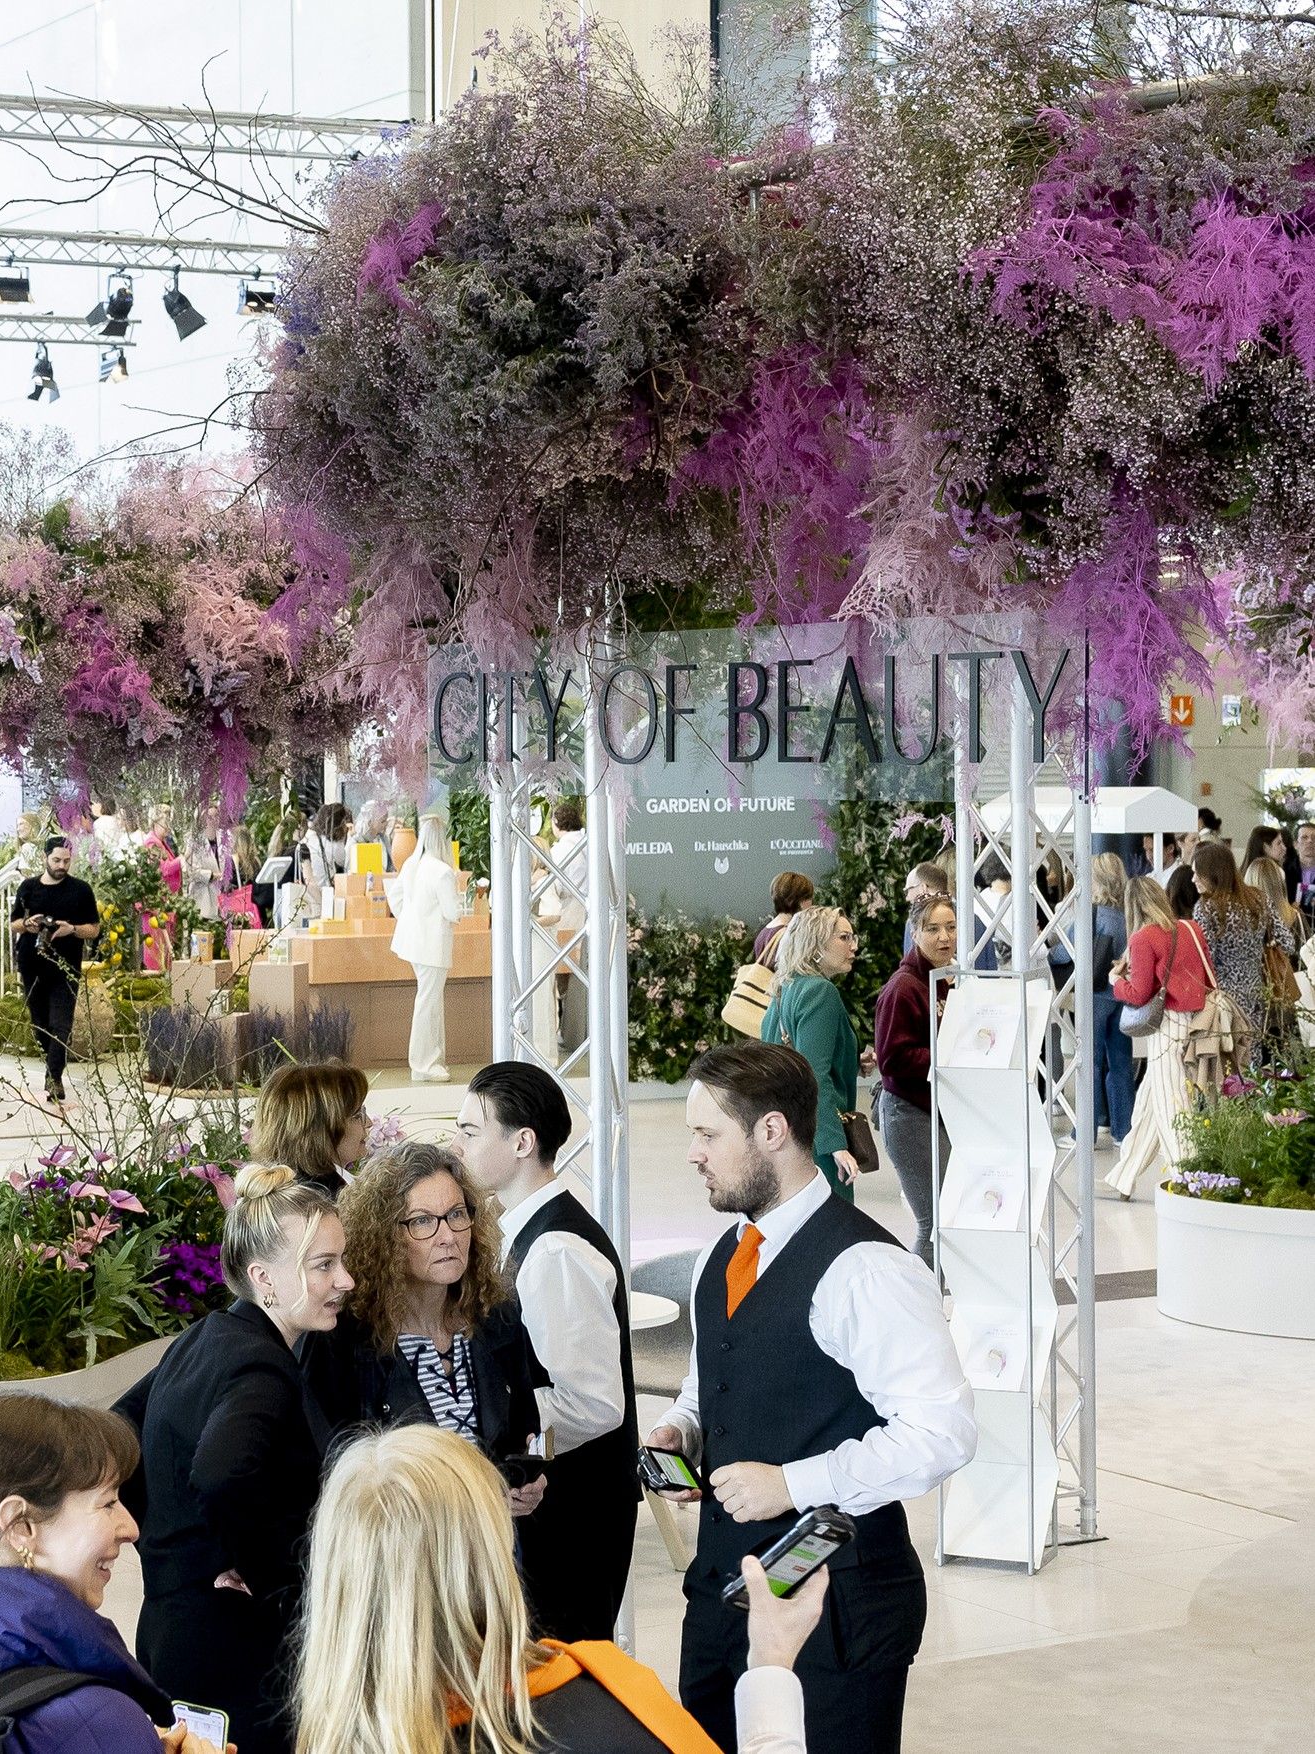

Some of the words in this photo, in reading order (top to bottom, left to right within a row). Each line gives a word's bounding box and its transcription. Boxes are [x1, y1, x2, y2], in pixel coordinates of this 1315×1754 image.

[433, 669, 572, 765] CITY
[597, 662, 698, 765] OF
[727, 647, 1070, 765] BEAUTY
[645, 798, 710, 815] GARDEN
[739, 796, 796, 812] FUTURE
